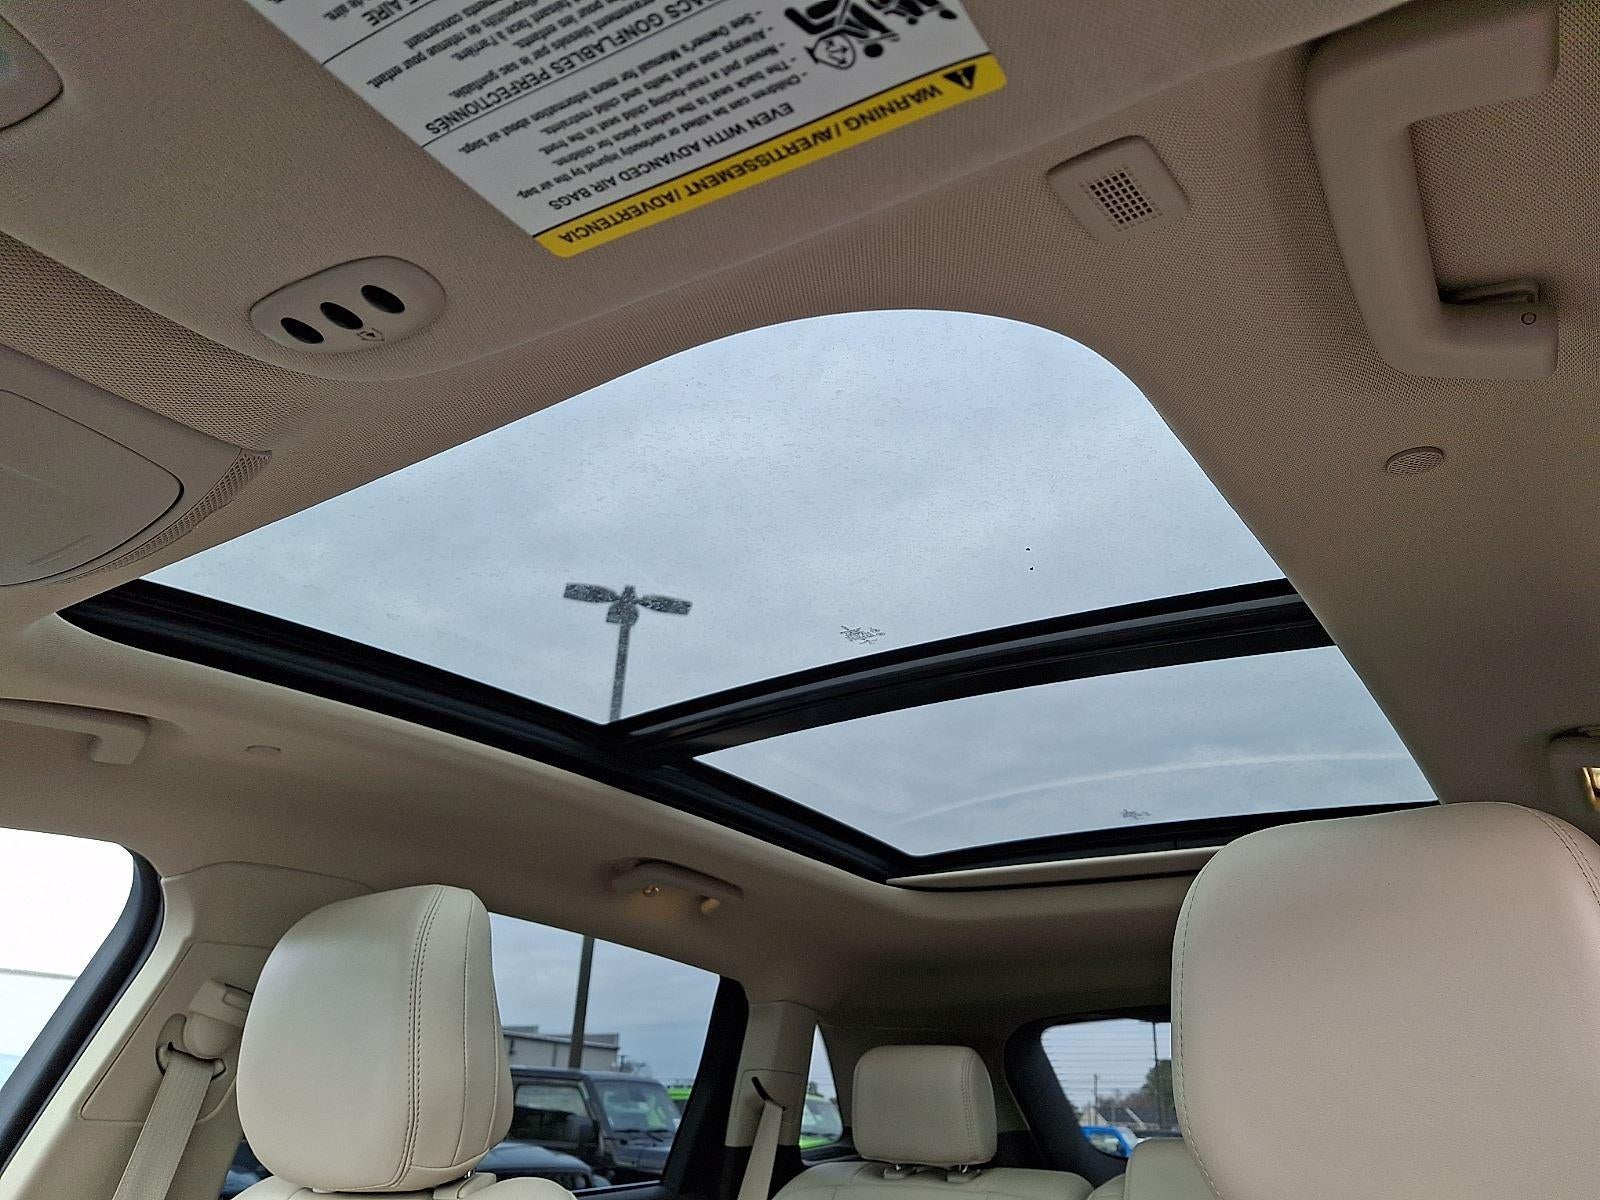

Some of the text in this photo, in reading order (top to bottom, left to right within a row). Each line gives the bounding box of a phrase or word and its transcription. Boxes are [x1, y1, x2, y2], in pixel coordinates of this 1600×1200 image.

[360, 0, 403, 27] AIRE
[556, 14, 579, 29] les
[729, 12, 756, 30] See
[403, 12, 464, 50] concernant
[464, 23, 482, 36] de
[504, 17, 534, 36] face
[425, 31, 468, 58] retenue
[549, 12, 665, 75] GONFLABLES
[679, 25, 731, 53] Owner's
[721, 28, 767, 55] Always
[401, 50, 428, 71] pour
[518, 55, 534, 67] le
[531, 43, 552, 61] par
[637, 48, 683, 75] Manual
[698, 49, 722, 66] use
[743, 44, 780, 67] Never
[497, 61, 520, 77] sac
[620, 68, 640, 83] for
[671, 60, 699, 79] seat
[709, 71, 721, 80] a
[719, 58, 743, 78] put
[765, 60, 791, 75] The
[589, 76, 620, 96] more
[642, 72, 675, 91] belts
[733, 70, 767, 89] back
[750, 73, 802, 101] Children
[619, 86, 644, 103] and
[647, 75, 711, 108] rear-facing
[695, 95, 710, 107] is
[707, 84, 735, 102] seat
[529, 90, 593, 122] information
[592, 96, 621, 115] child
[620, 103, 650, 122] child
[675, 101, 698, 115] the
[712, 105, 731, 118] be
[727, 95, 752, 111] can
[842, 83, 944, 132] WARNING
[499, 117, 532, 137] about
[596, 115, 622, 132] seat
[640, 110, 677, 131] safest
[680, 113, 714, 133] killed
[486, 131, 502, 144] air
[566, 131, 588, 143] the
[584, 125, 600, 136] in
[611, 123, 643, 143] place
[667, 126, 681, 137] or
[596, 137, 614, 150] for
[619, 132, 668, 157] seriously
[547, 101, 795, 211] EVEN WITH ADVANCED AIR BAGS
[583, 152, 623, 173] injured
[552, 172, 574, 185] the
[569, 167, 587, 178] by
[539, 180, 555, 191] air
